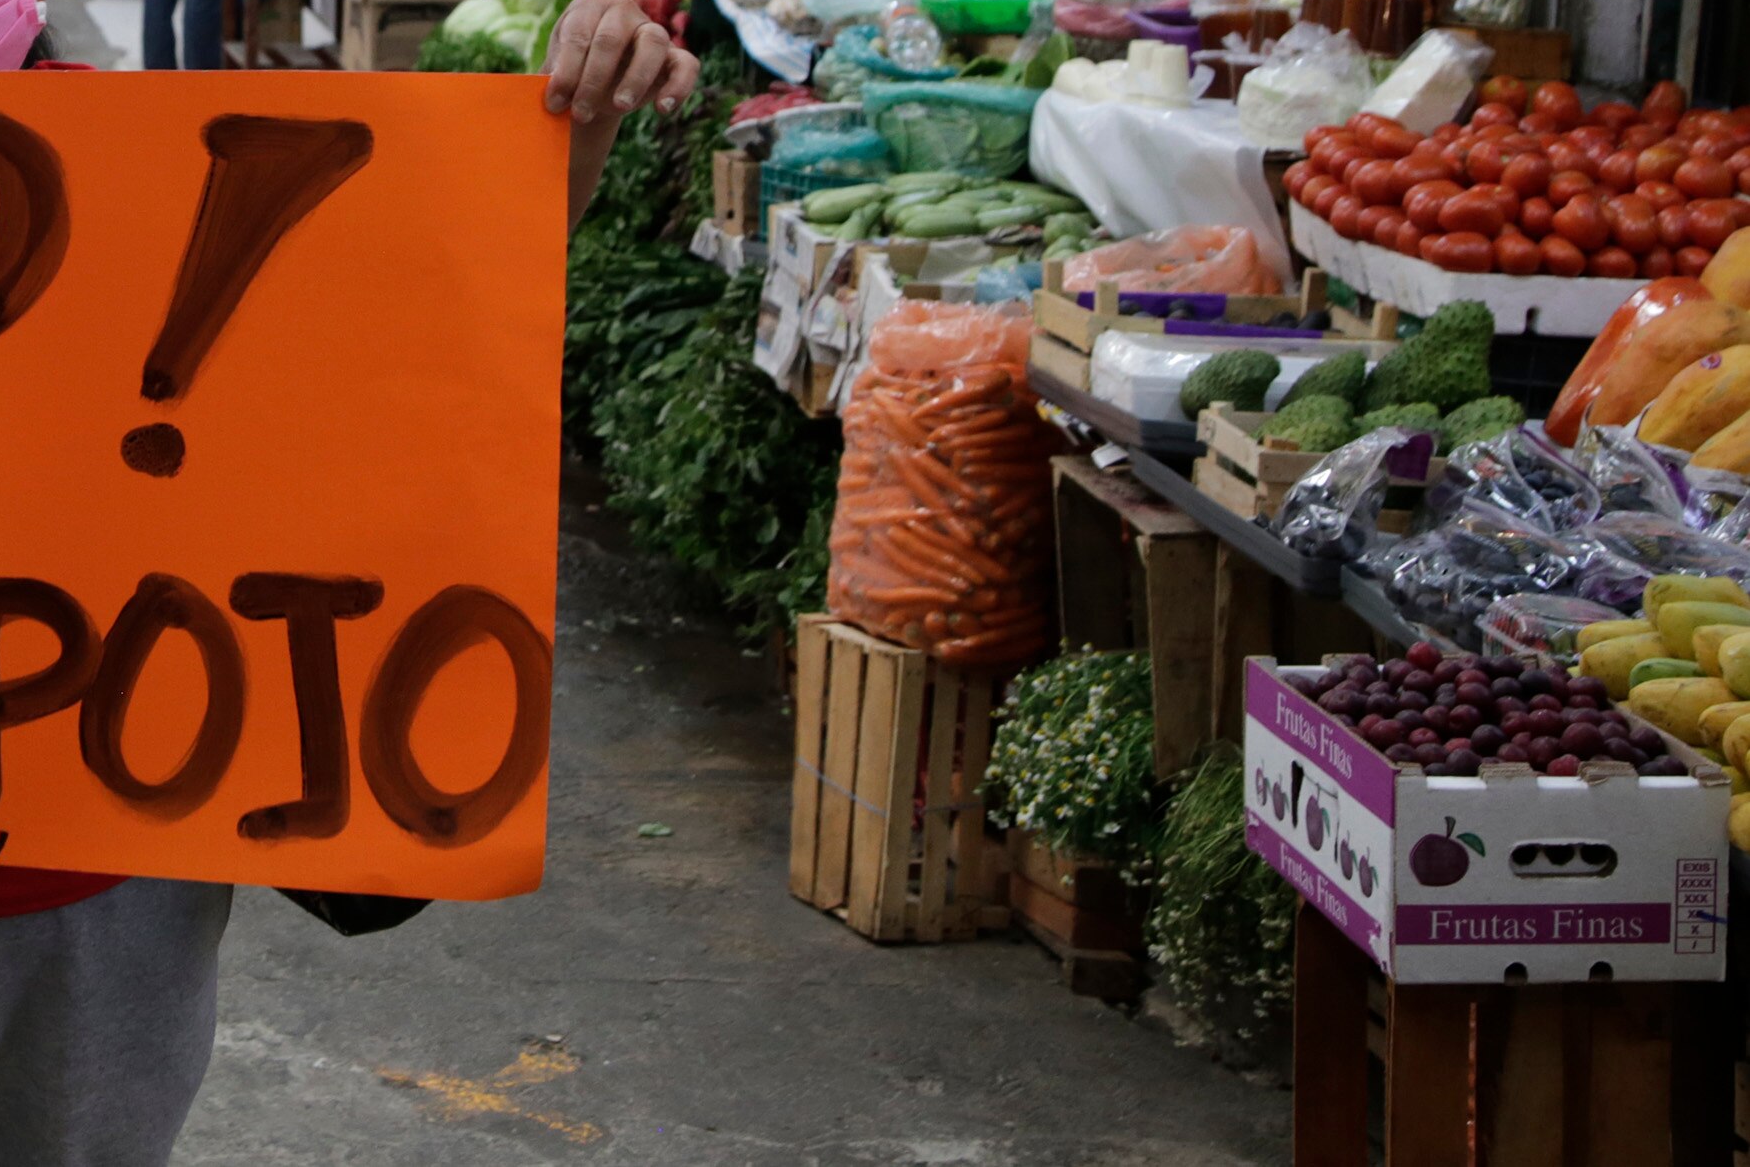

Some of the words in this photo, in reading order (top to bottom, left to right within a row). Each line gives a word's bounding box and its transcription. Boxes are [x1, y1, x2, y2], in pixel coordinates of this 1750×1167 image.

[1276, 691, 1317, 750] Frutas
[1319, 722, 1352, 779] Finas
[1280, 841, 1315, 897] Frutas
[1316, 873, 1348, 926] Finas
[1683, 893, 1708, 904] XXX
[1428, 910, 1537, 940] Frutas
[1551, 909, 1644, 939] Finas
